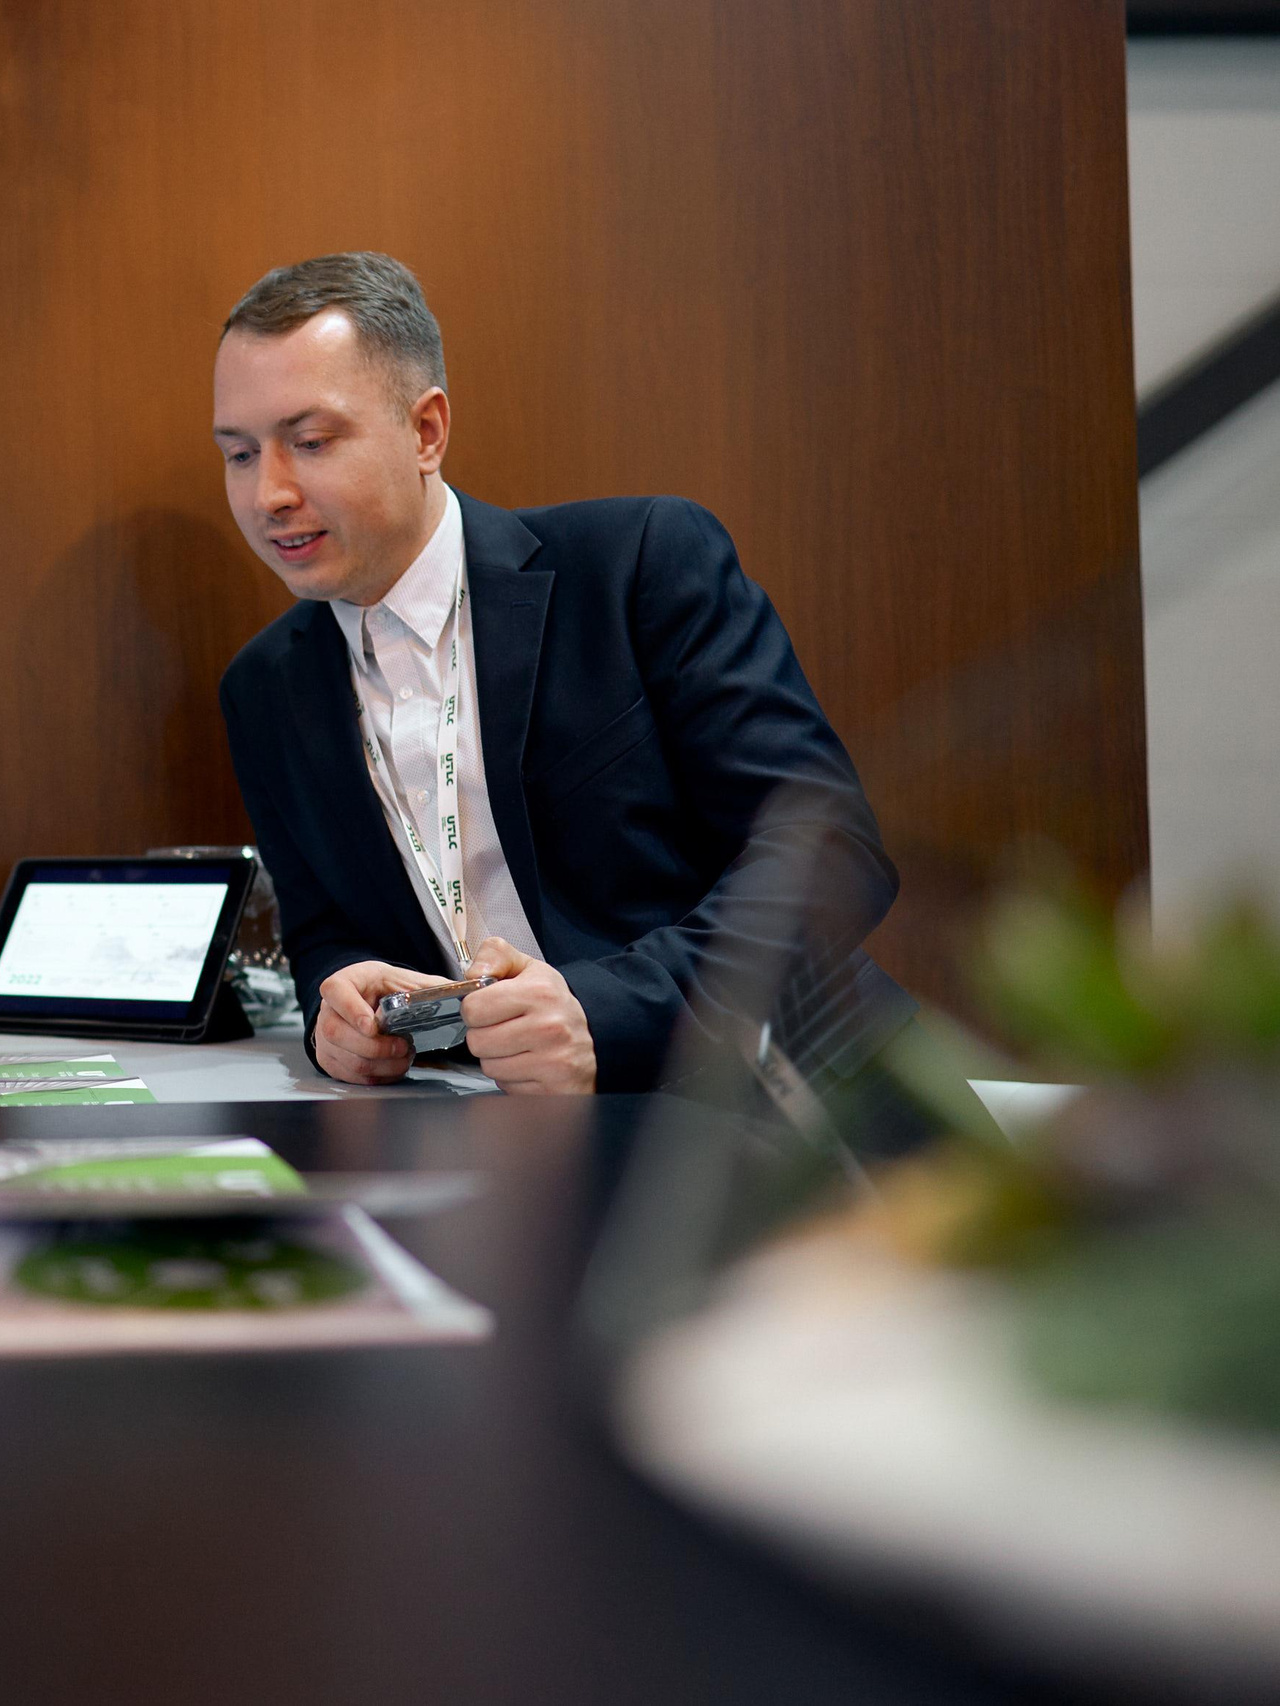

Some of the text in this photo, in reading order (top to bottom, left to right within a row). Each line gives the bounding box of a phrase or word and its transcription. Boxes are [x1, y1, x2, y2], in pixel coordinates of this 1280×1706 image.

[446, 695, 456, 726] UTLC
[445, 752, 454, 787] UTLC
[405, 823, 422, 852] UTLC
[446, 815, 458, 850] UTLC
[428, 877, 447, 907] UTLC
[452, 880, 463, 915] UTLC
